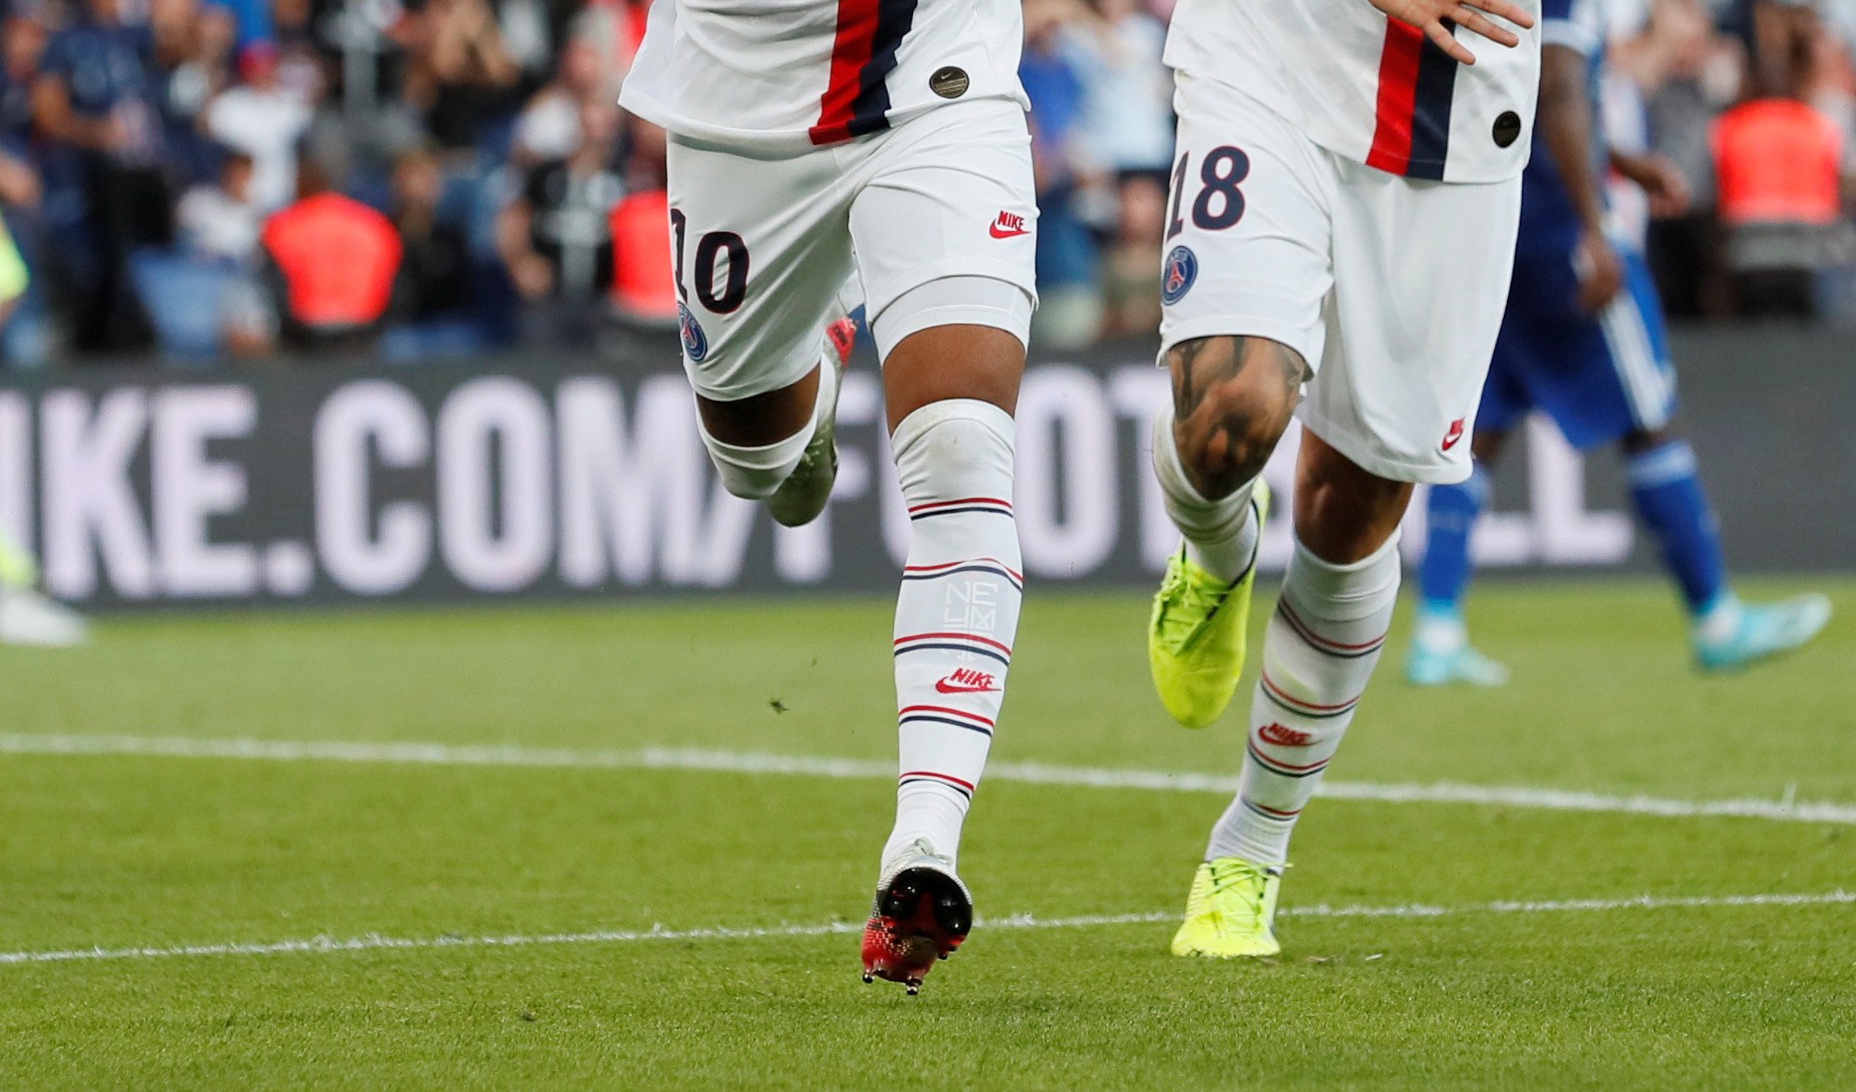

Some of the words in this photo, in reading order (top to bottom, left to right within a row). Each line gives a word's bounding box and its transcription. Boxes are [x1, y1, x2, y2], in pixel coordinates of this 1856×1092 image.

[997, 210, 1025, 231] NIKE
[1166, 145, 1250, 244] 18
[670, 208, 750, 315] 10
[950, 667, 995, 687] NIKE
